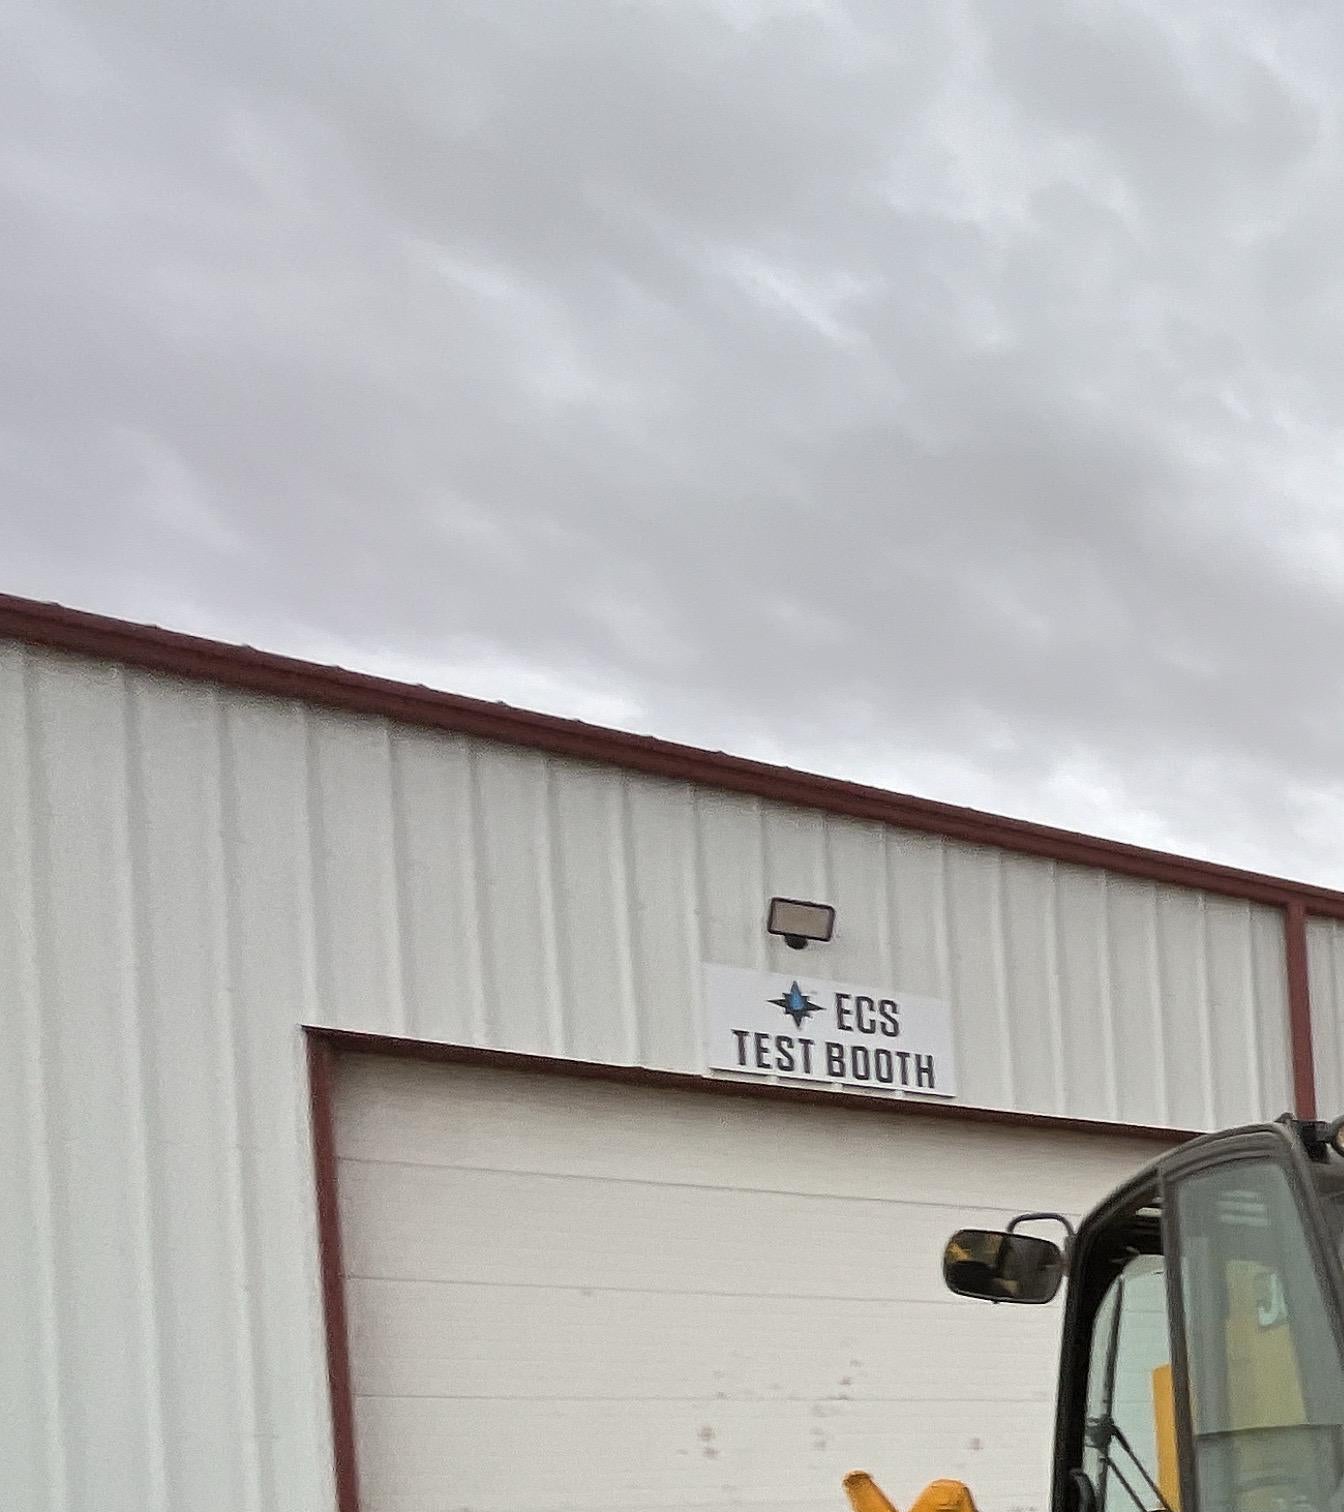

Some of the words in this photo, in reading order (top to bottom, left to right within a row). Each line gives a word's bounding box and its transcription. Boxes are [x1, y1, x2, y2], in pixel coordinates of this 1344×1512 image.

[834, 992, 901, 1037] ECS
[731, 1028, 815, 1074] TEST
[825, 1040, 936, 1088] BOOTH
